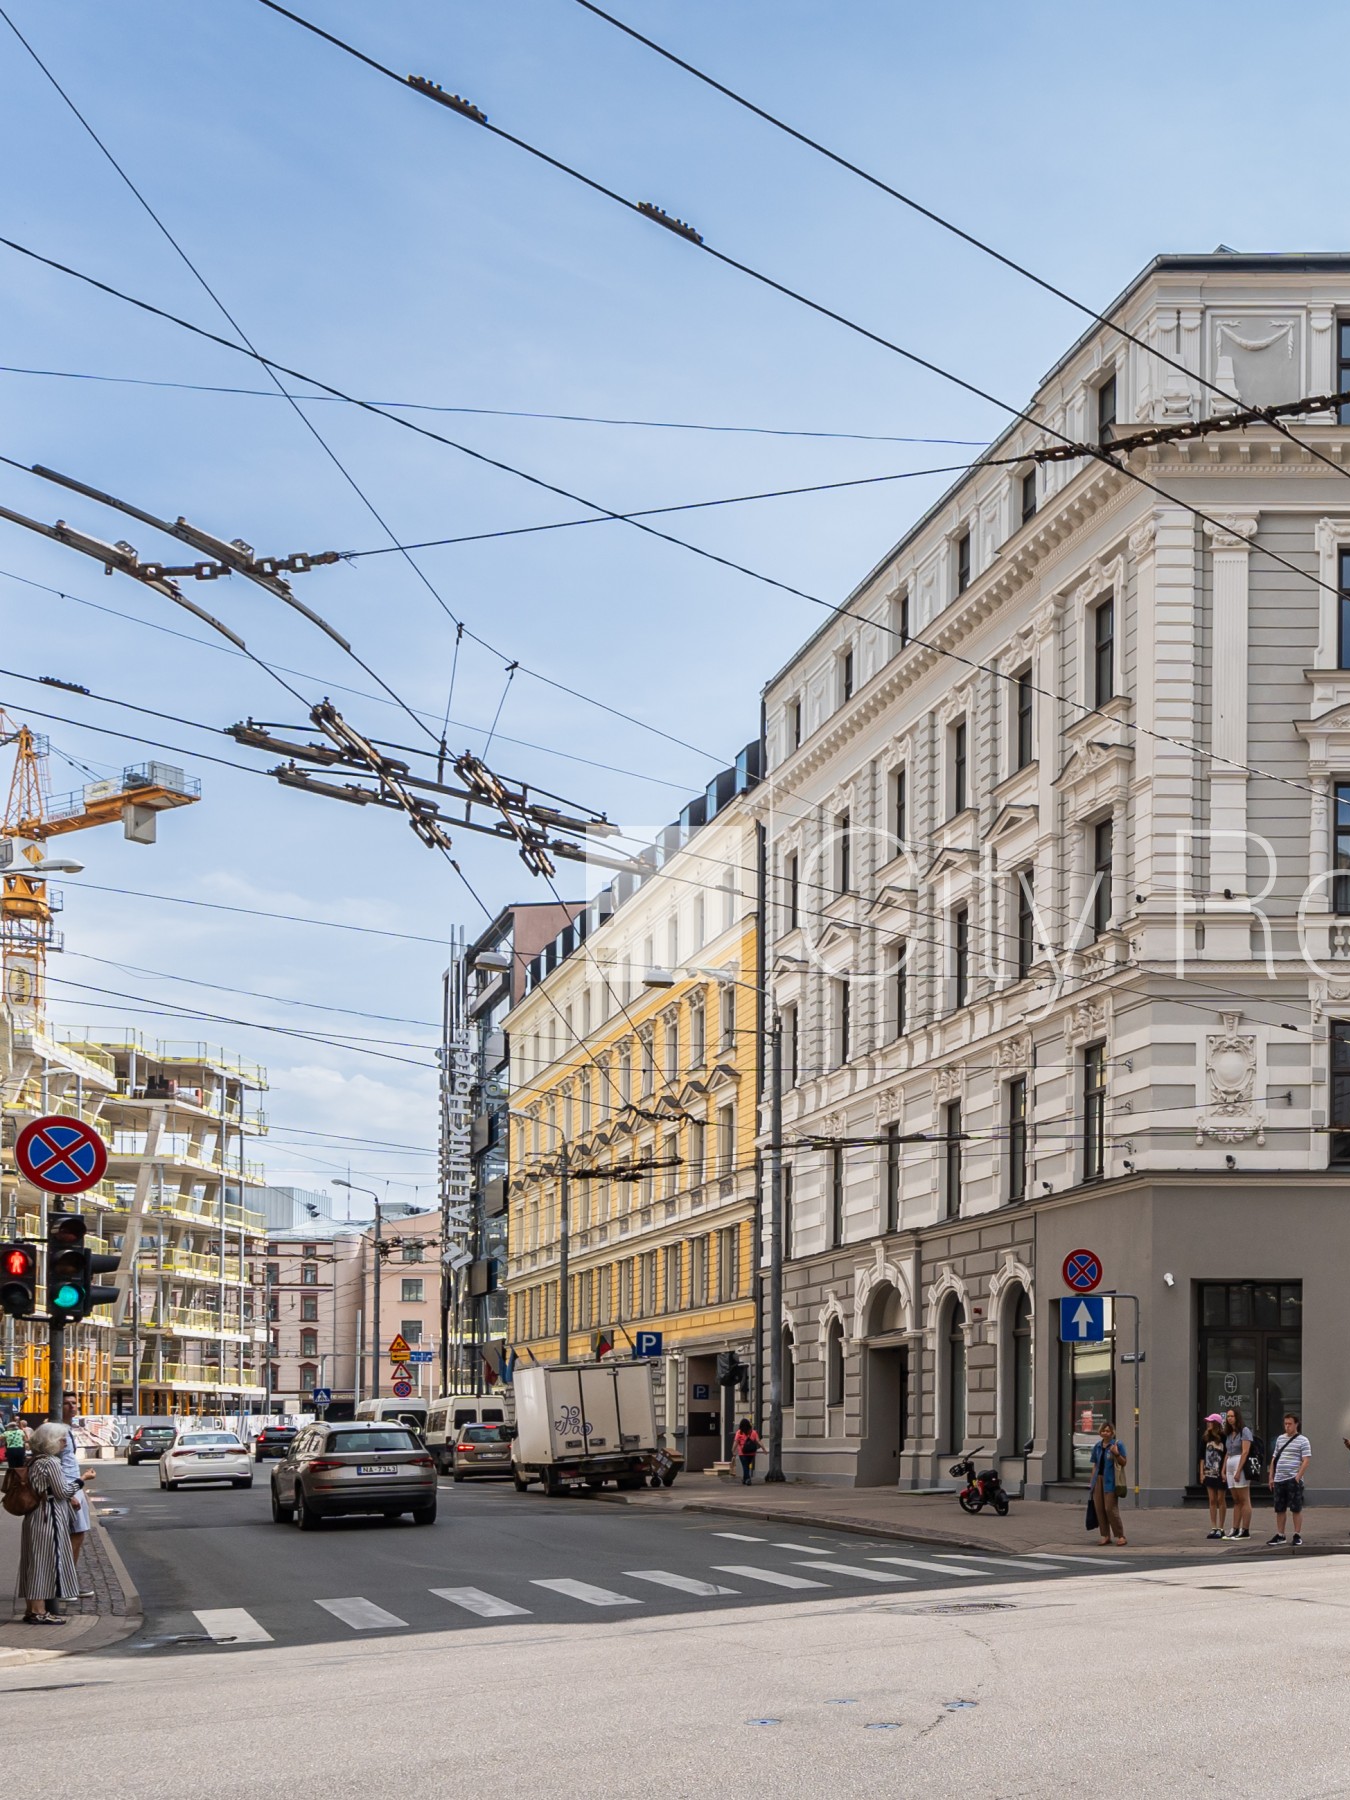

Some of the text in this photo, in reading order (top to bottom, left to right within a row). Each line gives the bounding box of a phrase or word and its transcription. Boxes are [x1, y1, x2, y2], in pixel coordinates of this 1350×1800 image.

[448, 1028, 472, 1237] TALLINK Hotels
[642, 1334, 656, 1353] P
[696, 1385, 706, 1398] P
